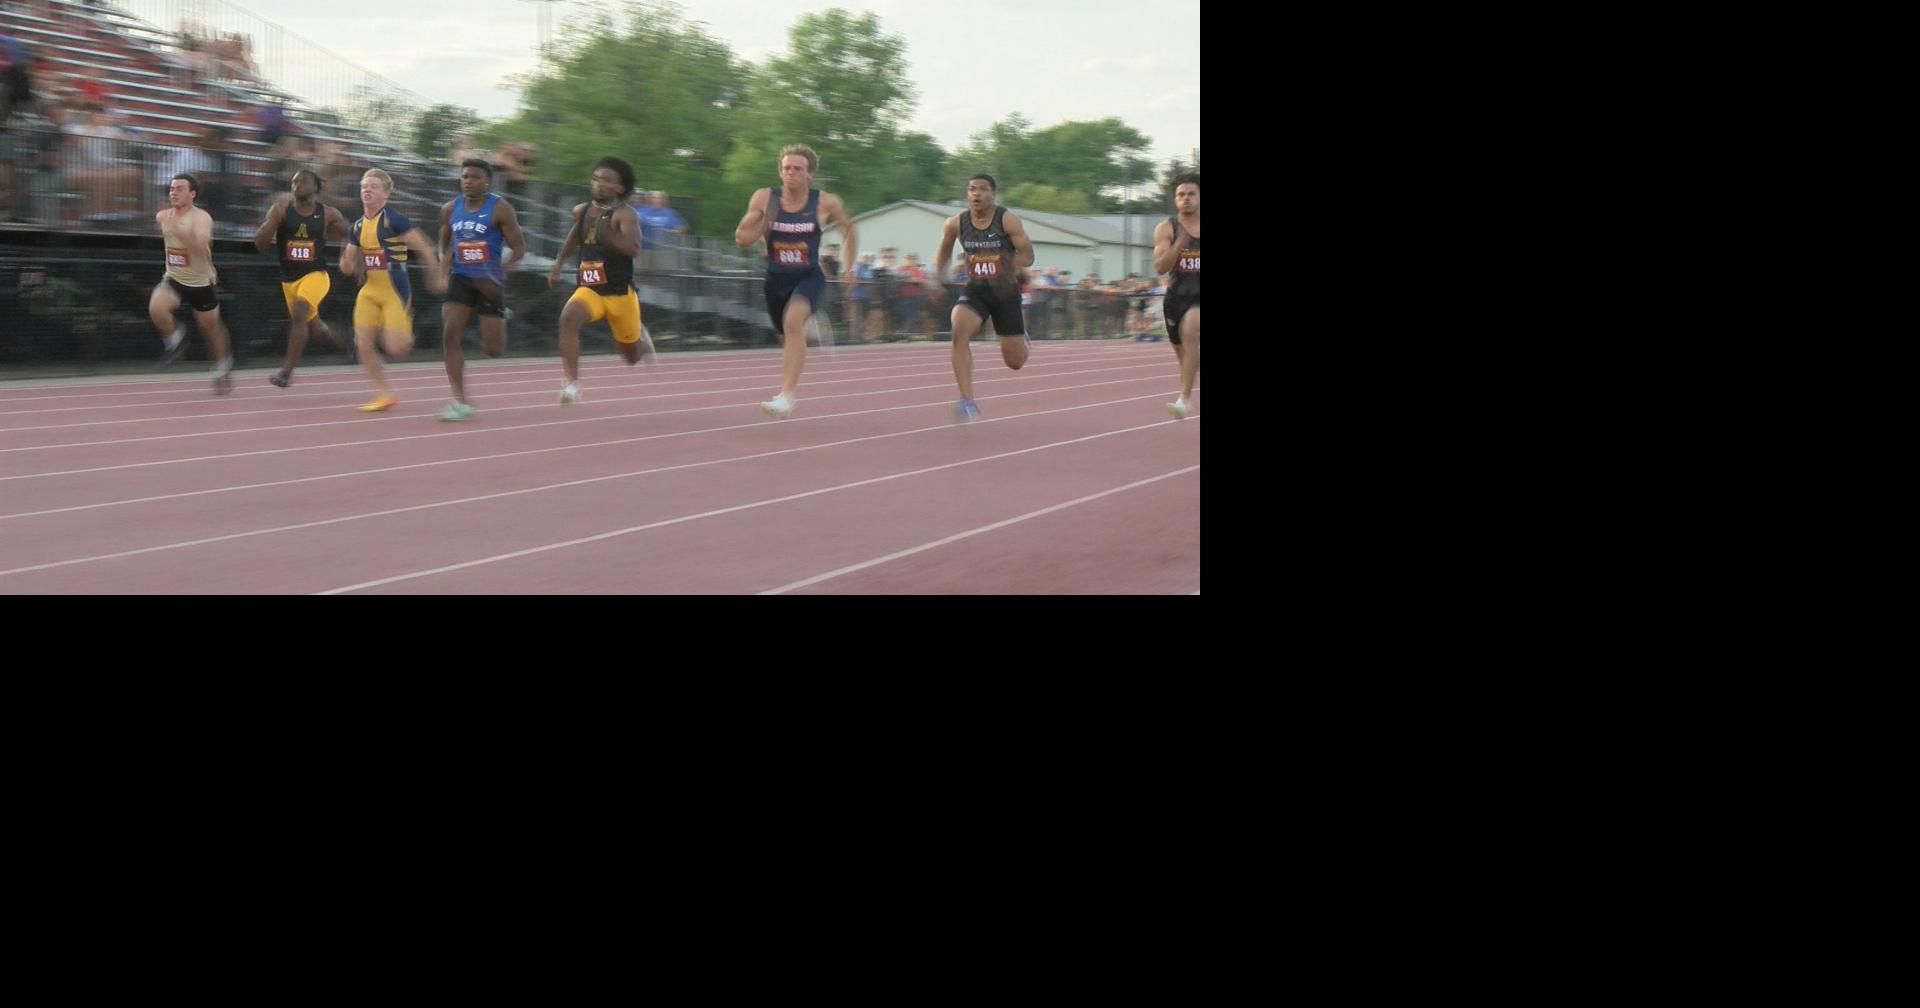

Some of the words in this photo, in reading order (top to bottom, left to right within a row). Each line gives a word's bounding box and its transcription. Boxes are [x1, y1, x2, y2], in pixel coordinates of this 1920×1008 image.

[291, 248, 310, 259] 418
[974, 262, 996, 275] 440
[1180, 257, 1200, 270] 438
[582, 270, 601, 283] 424
